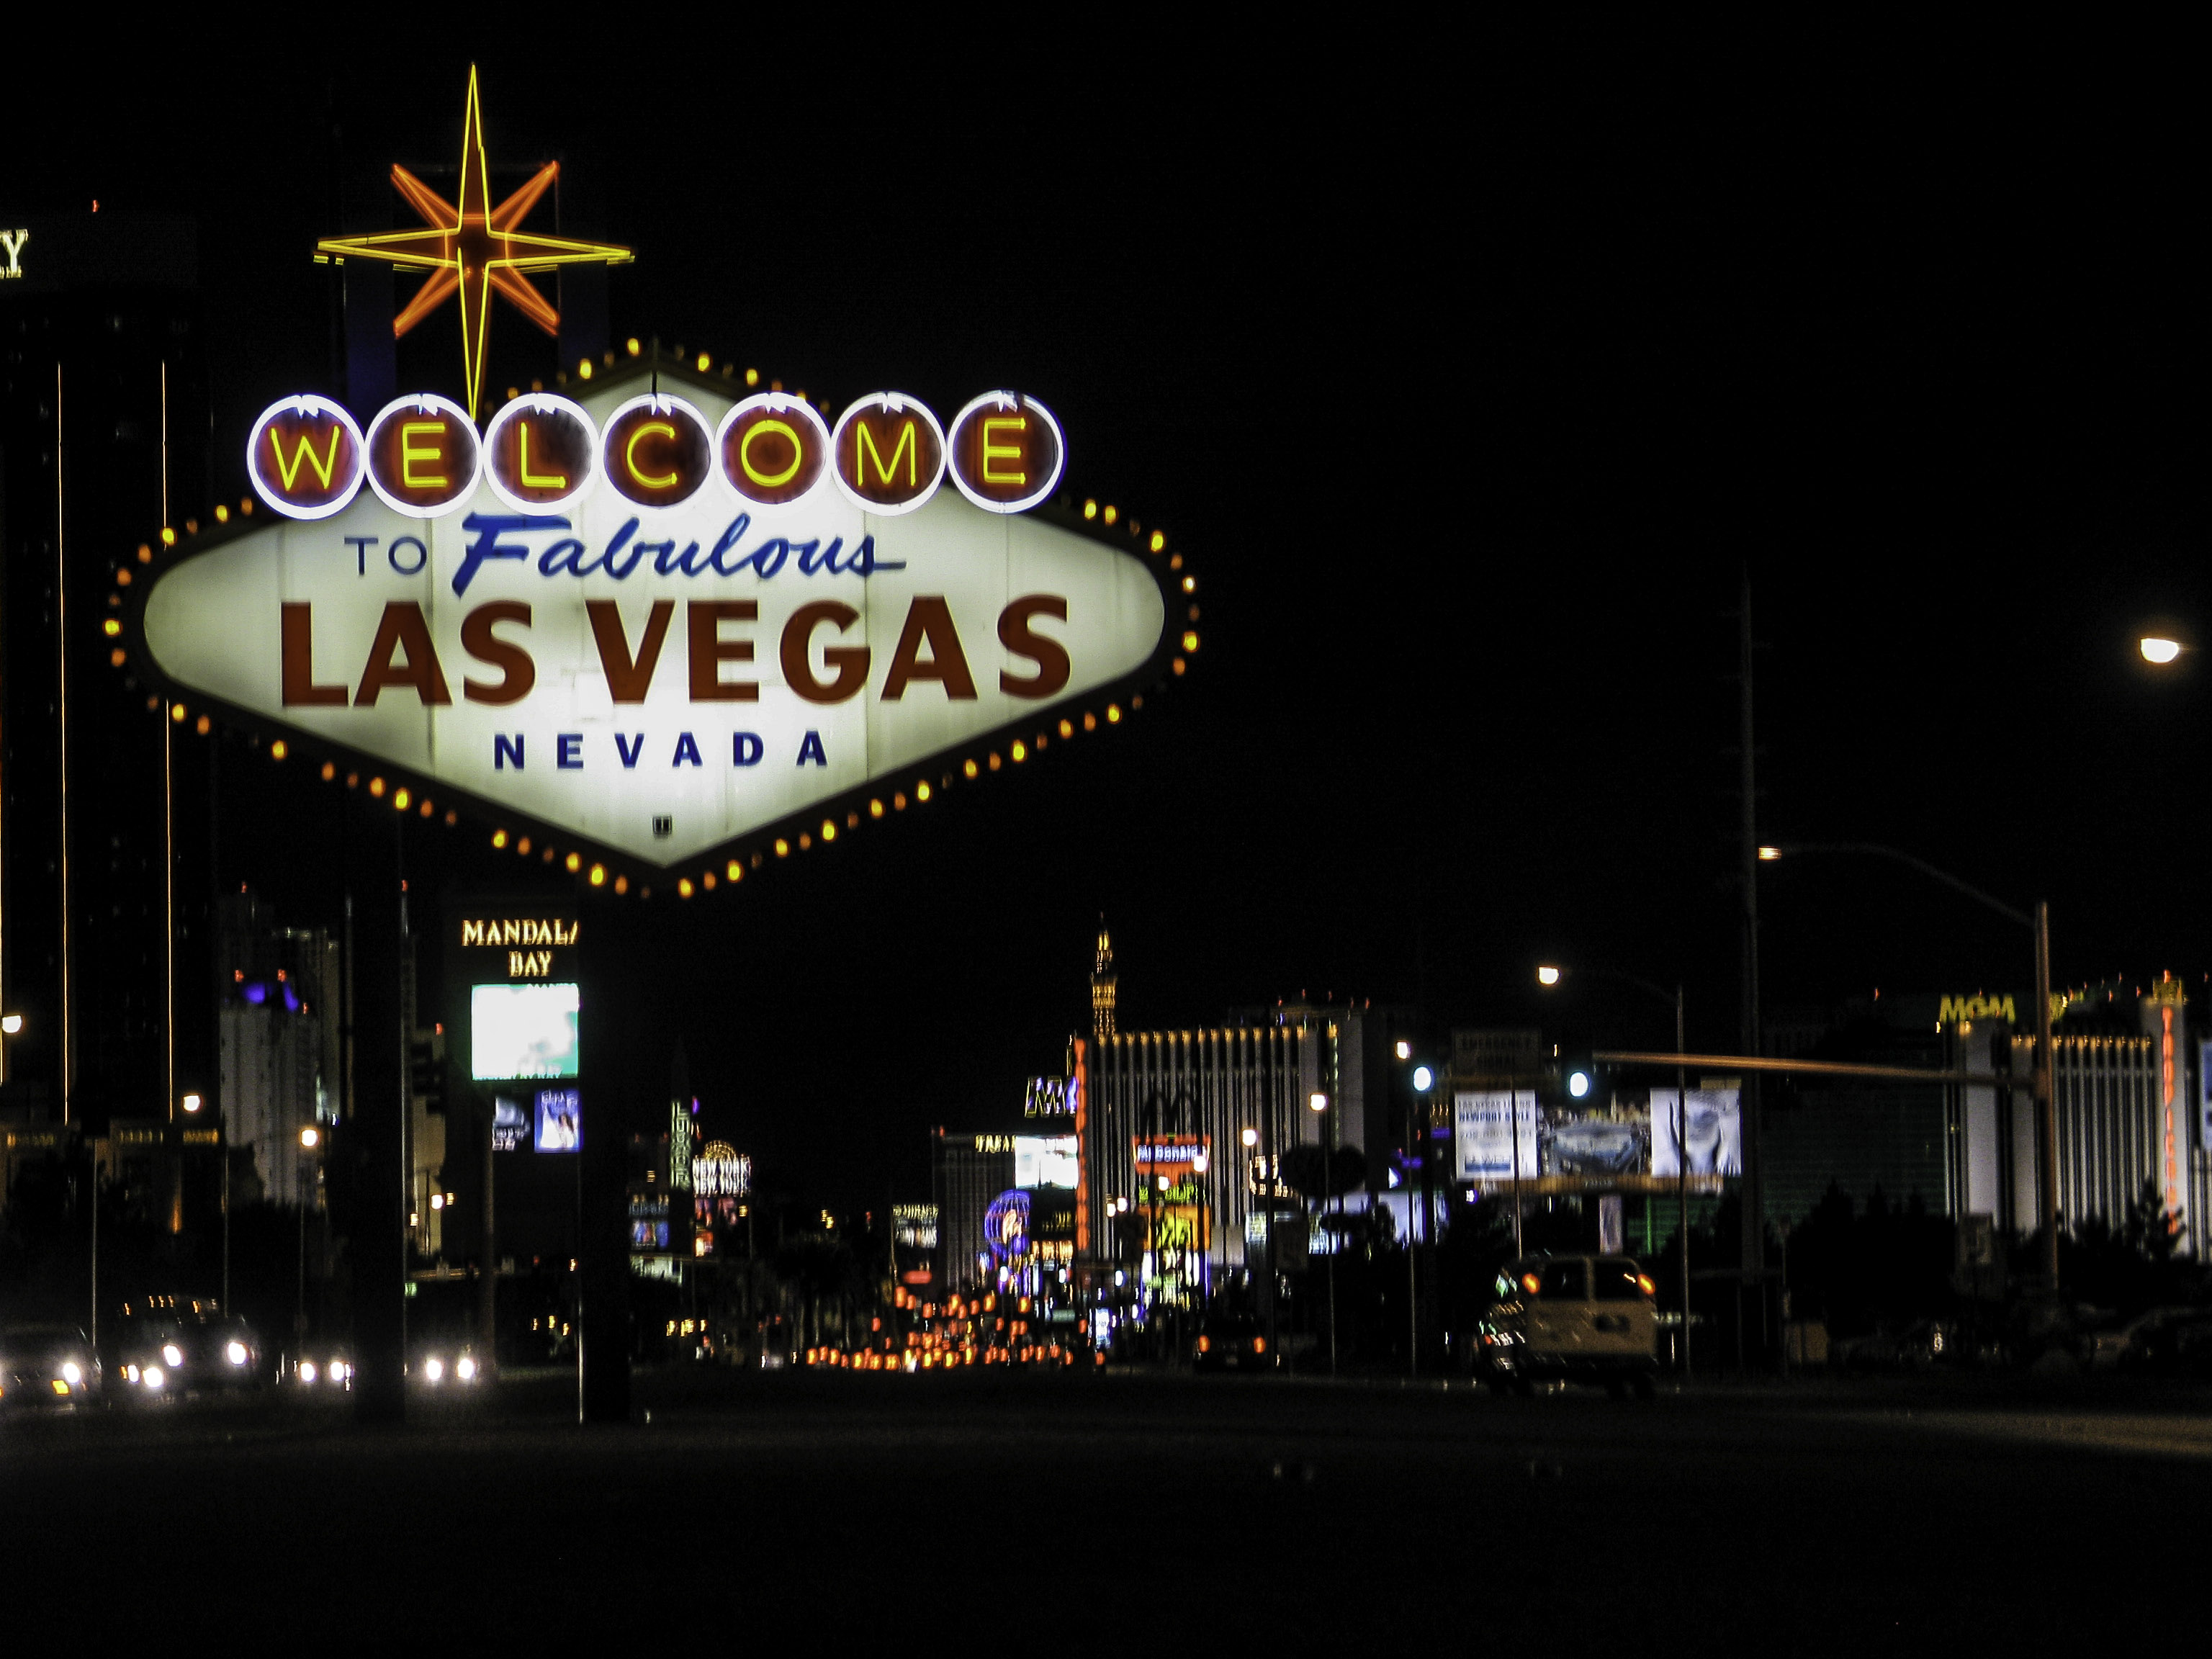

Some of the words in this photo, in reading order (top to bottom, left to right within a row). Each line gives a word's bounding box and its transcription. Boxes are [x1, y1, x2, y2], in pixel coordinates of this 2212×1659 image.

[268, 415, 1030, 493] WELCOME
[343, 535, 428, 576] TO
[451, 511, 907, 599] Fabulous
[280, 598, 537, 708] LAS
[584, 593, 1071, 707] VEGAS
[493, 729, 828, 770] NEVADA
